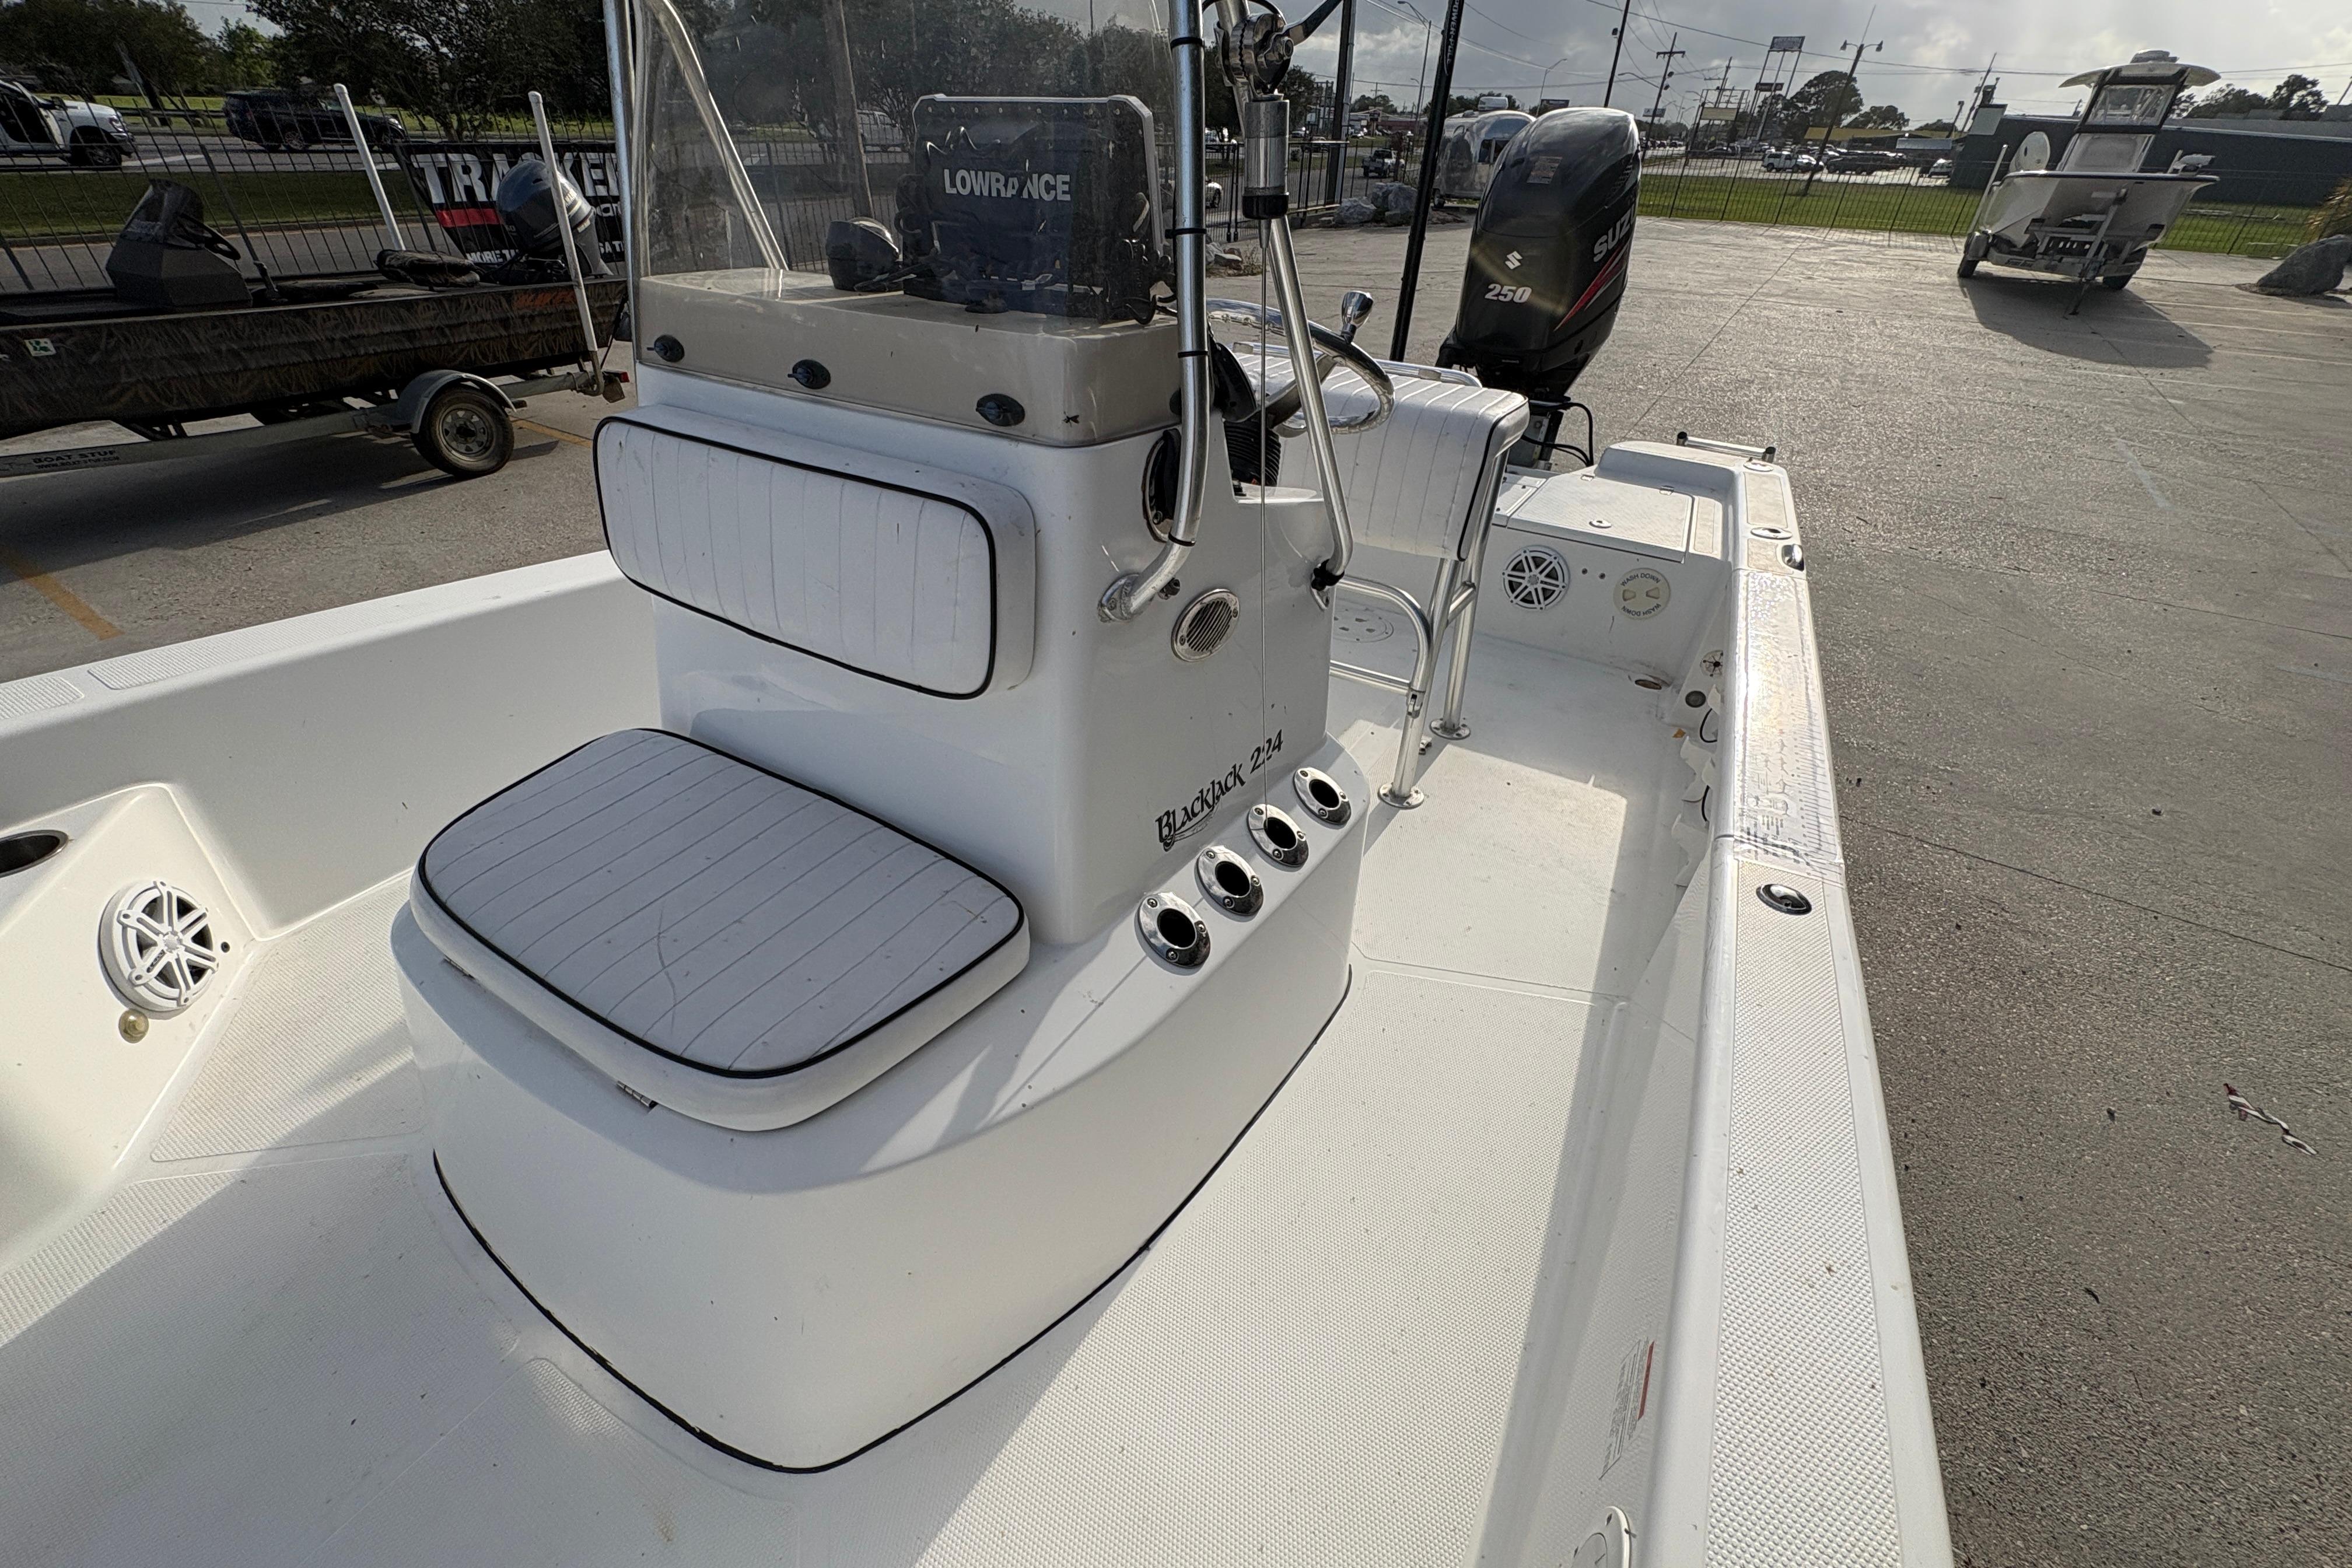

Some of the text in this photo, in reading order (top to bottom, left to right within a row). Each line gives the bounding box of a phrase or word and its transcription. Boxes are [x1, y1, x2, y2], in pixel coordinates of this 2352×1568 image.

[944, 169, 1071, 201] LOWRANCE
[467, 251, 503, 263] MORE
[1485, 284, 1532, 303] 250
[32, 454, 72, 464] BOAT
[1620, 572, 1660, 587] WASH DOWN
[1250, 729, 1283, 775] 224
